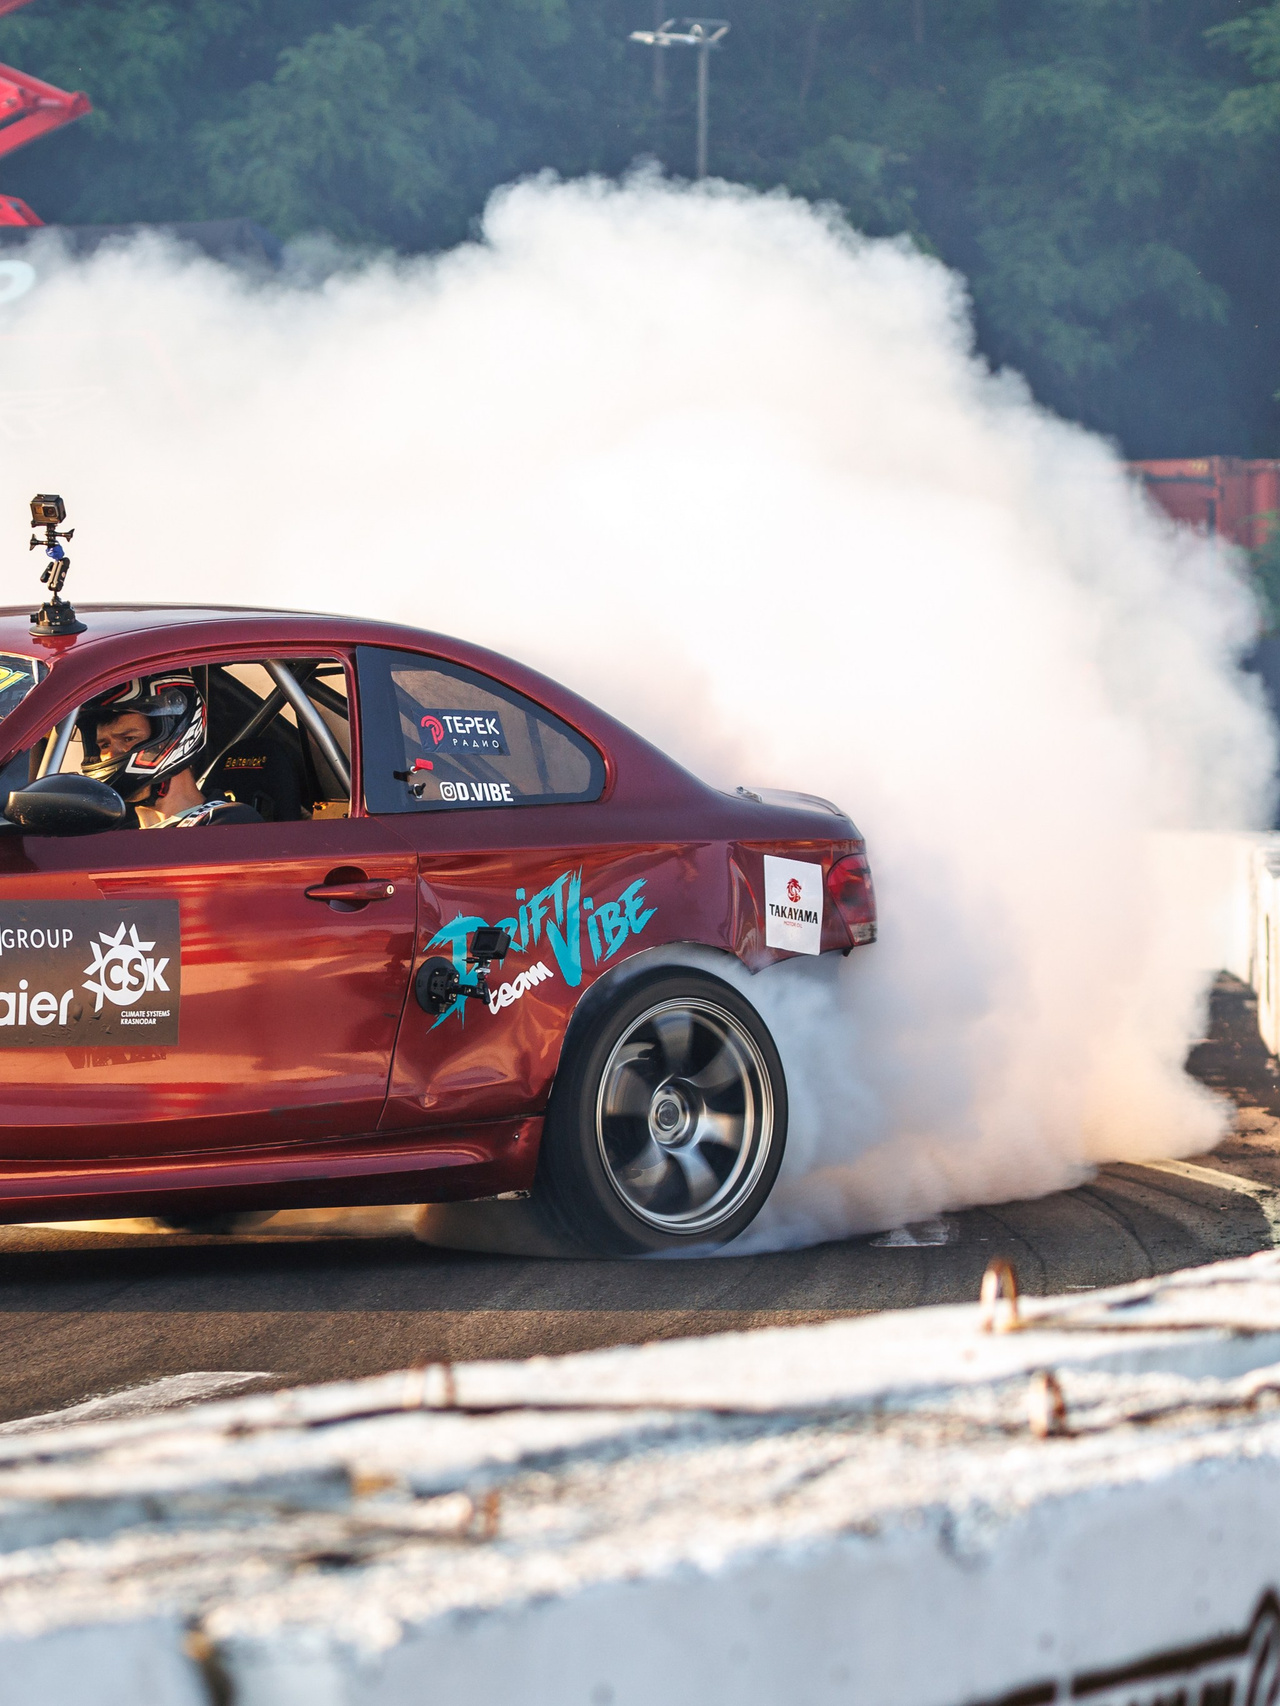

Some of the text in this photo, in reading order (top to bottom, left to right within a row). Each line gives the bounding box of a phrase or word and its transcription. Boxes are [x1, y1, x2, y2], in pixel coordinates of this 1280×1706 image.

[452, 738, 500, 749] РАДИО
[769, 903, 818, 924] TAKAYAMA
[103, 956, 170, 992] CSK
[487, 961, 554, 1015] team
[120, 1009, 171, 1018] CLIMATE SYSTEMS
